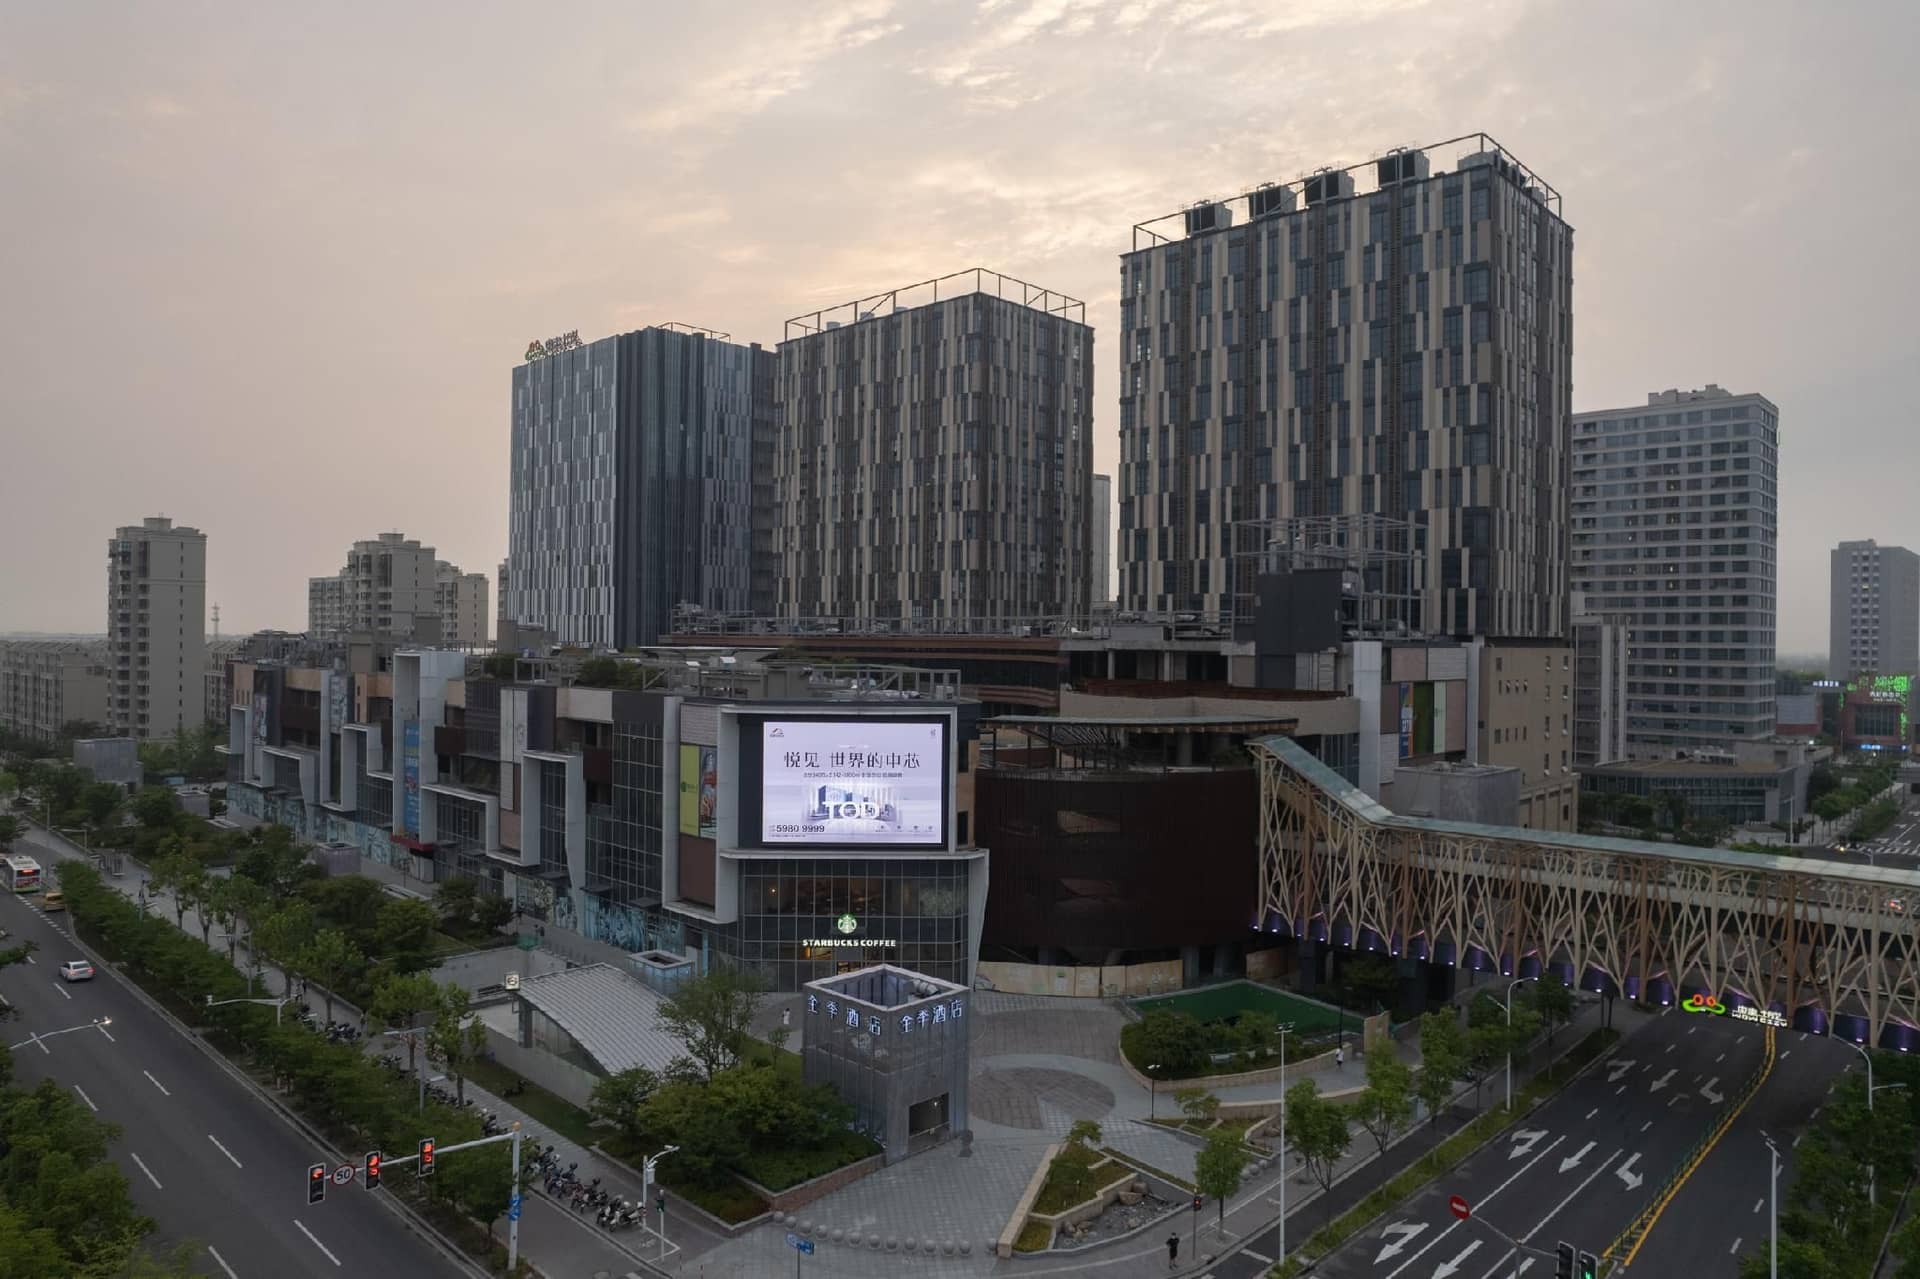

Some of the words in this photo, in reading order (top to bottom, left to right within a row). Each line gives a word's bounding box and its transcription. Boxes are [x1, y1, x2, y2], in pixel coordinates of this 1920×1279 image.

[784, 752, 820, 768] 悦见
[830, 752, 920, 768] 世界的中芯
[822, 801, 880, 820] TOD
[807, 995, 881, 1036] 全季酒店
[900, 999, 962, 1034] 全季酒店
[336, 1168, 351, 1181] 50
